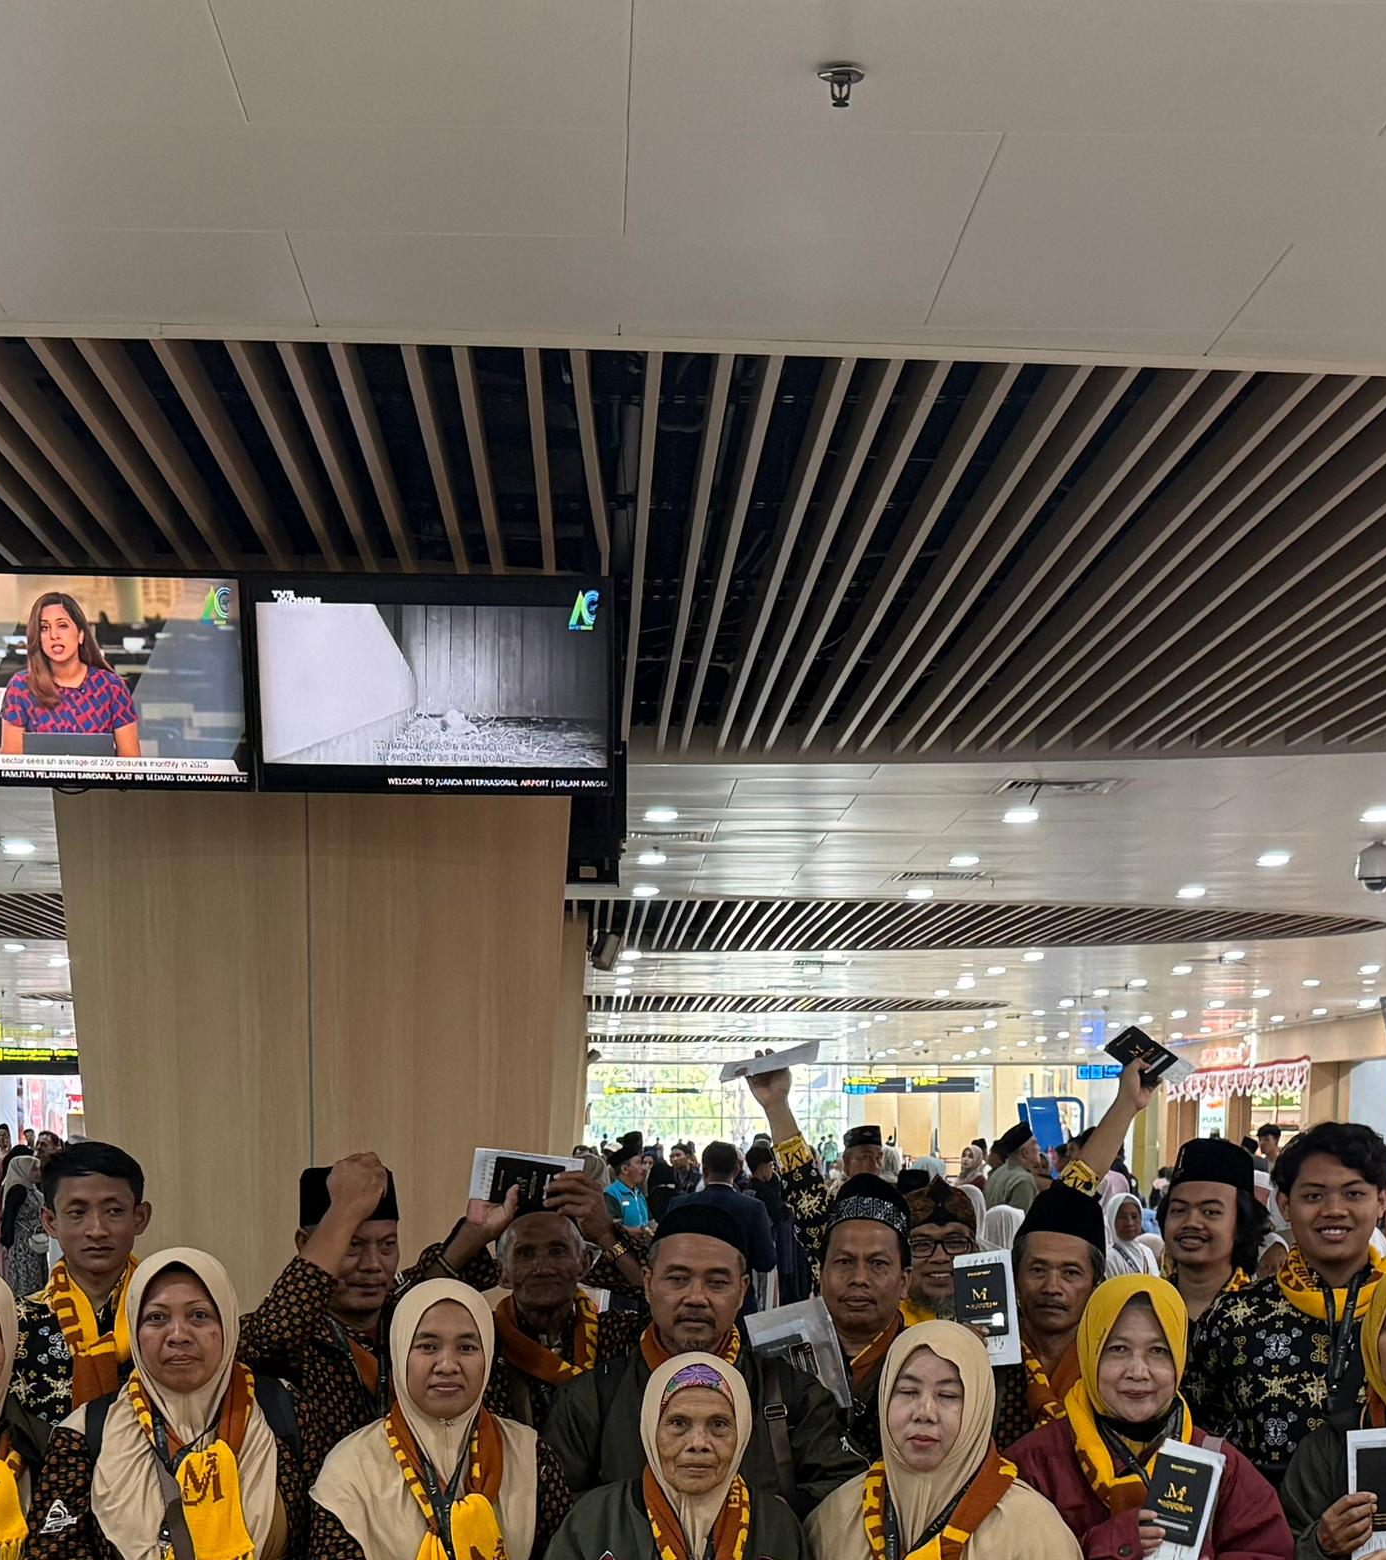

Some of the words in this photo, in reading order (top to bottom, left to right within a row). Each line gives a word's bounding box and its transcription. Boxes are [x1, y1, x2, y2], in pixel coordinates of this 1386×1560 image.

[387, 777, 423, 786] WELCOME
[424, 777, 435, 786] TO
[435, 778, 463, 787] JUANDA
[520, 779, 550, 787] AIRPORT
